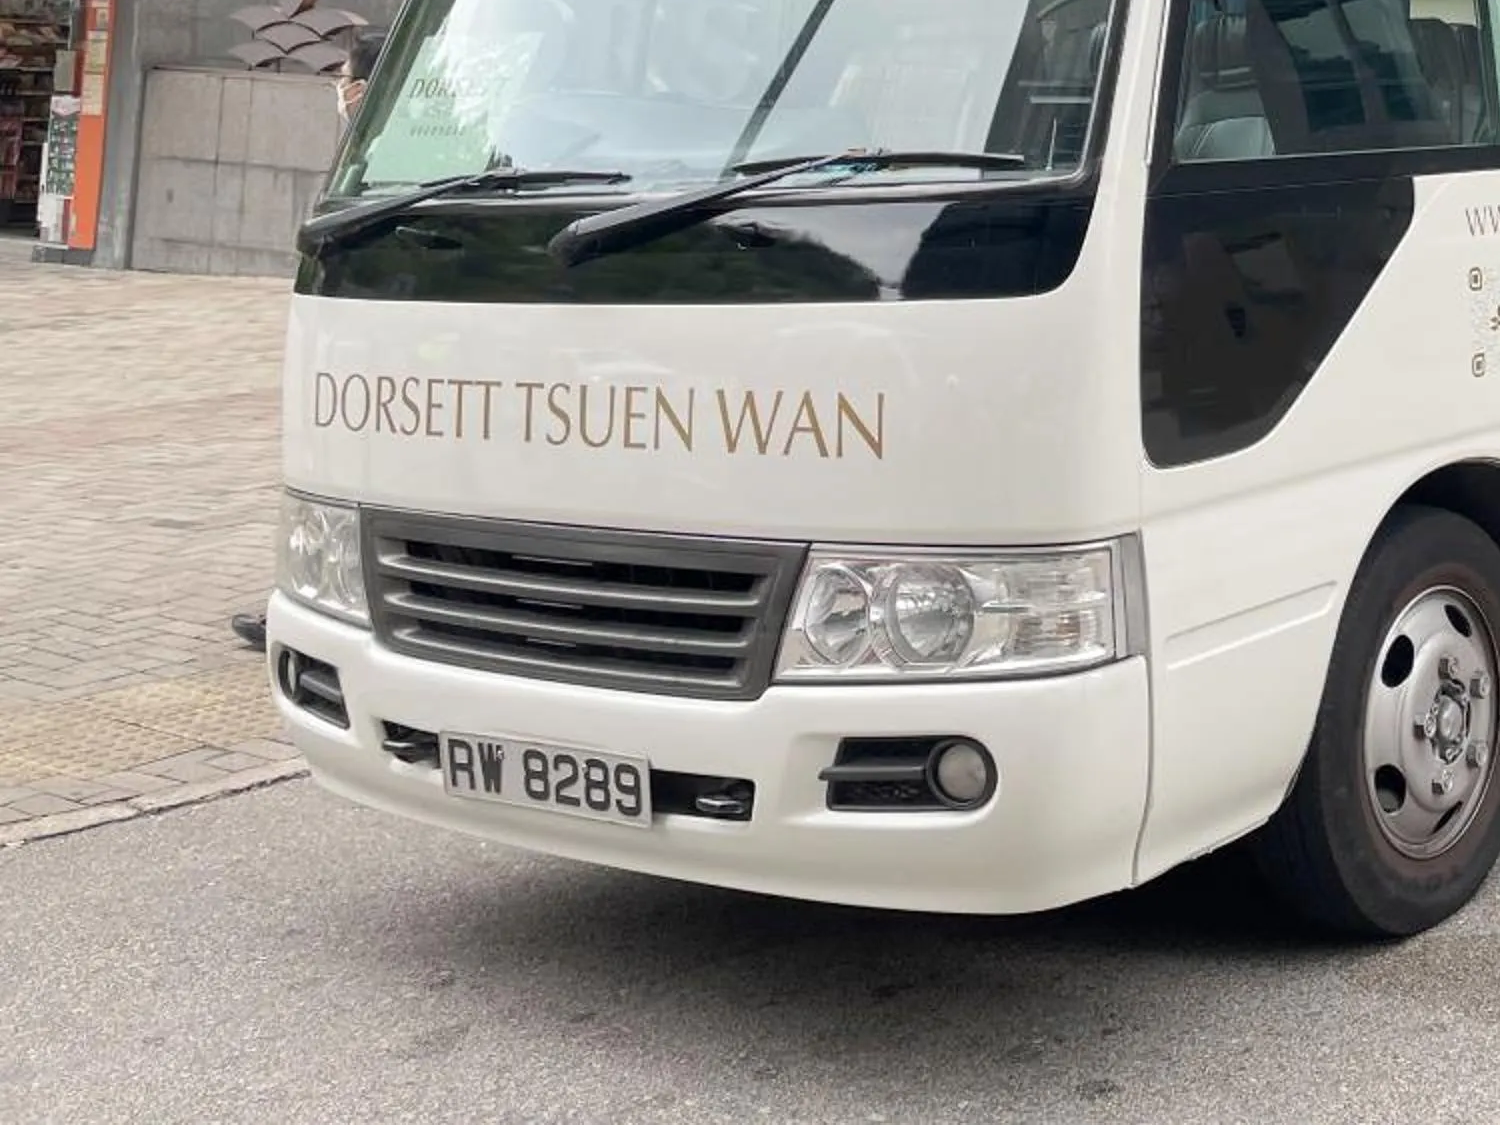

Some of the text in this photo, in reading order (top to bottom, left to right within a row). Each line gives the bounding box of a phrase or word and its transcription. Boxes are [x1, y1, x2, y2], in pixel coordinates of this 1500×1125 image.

[314, 371, 885, 460] DORSETT TSUEN WAN
[447, 737, 643, 817] RW 8289
